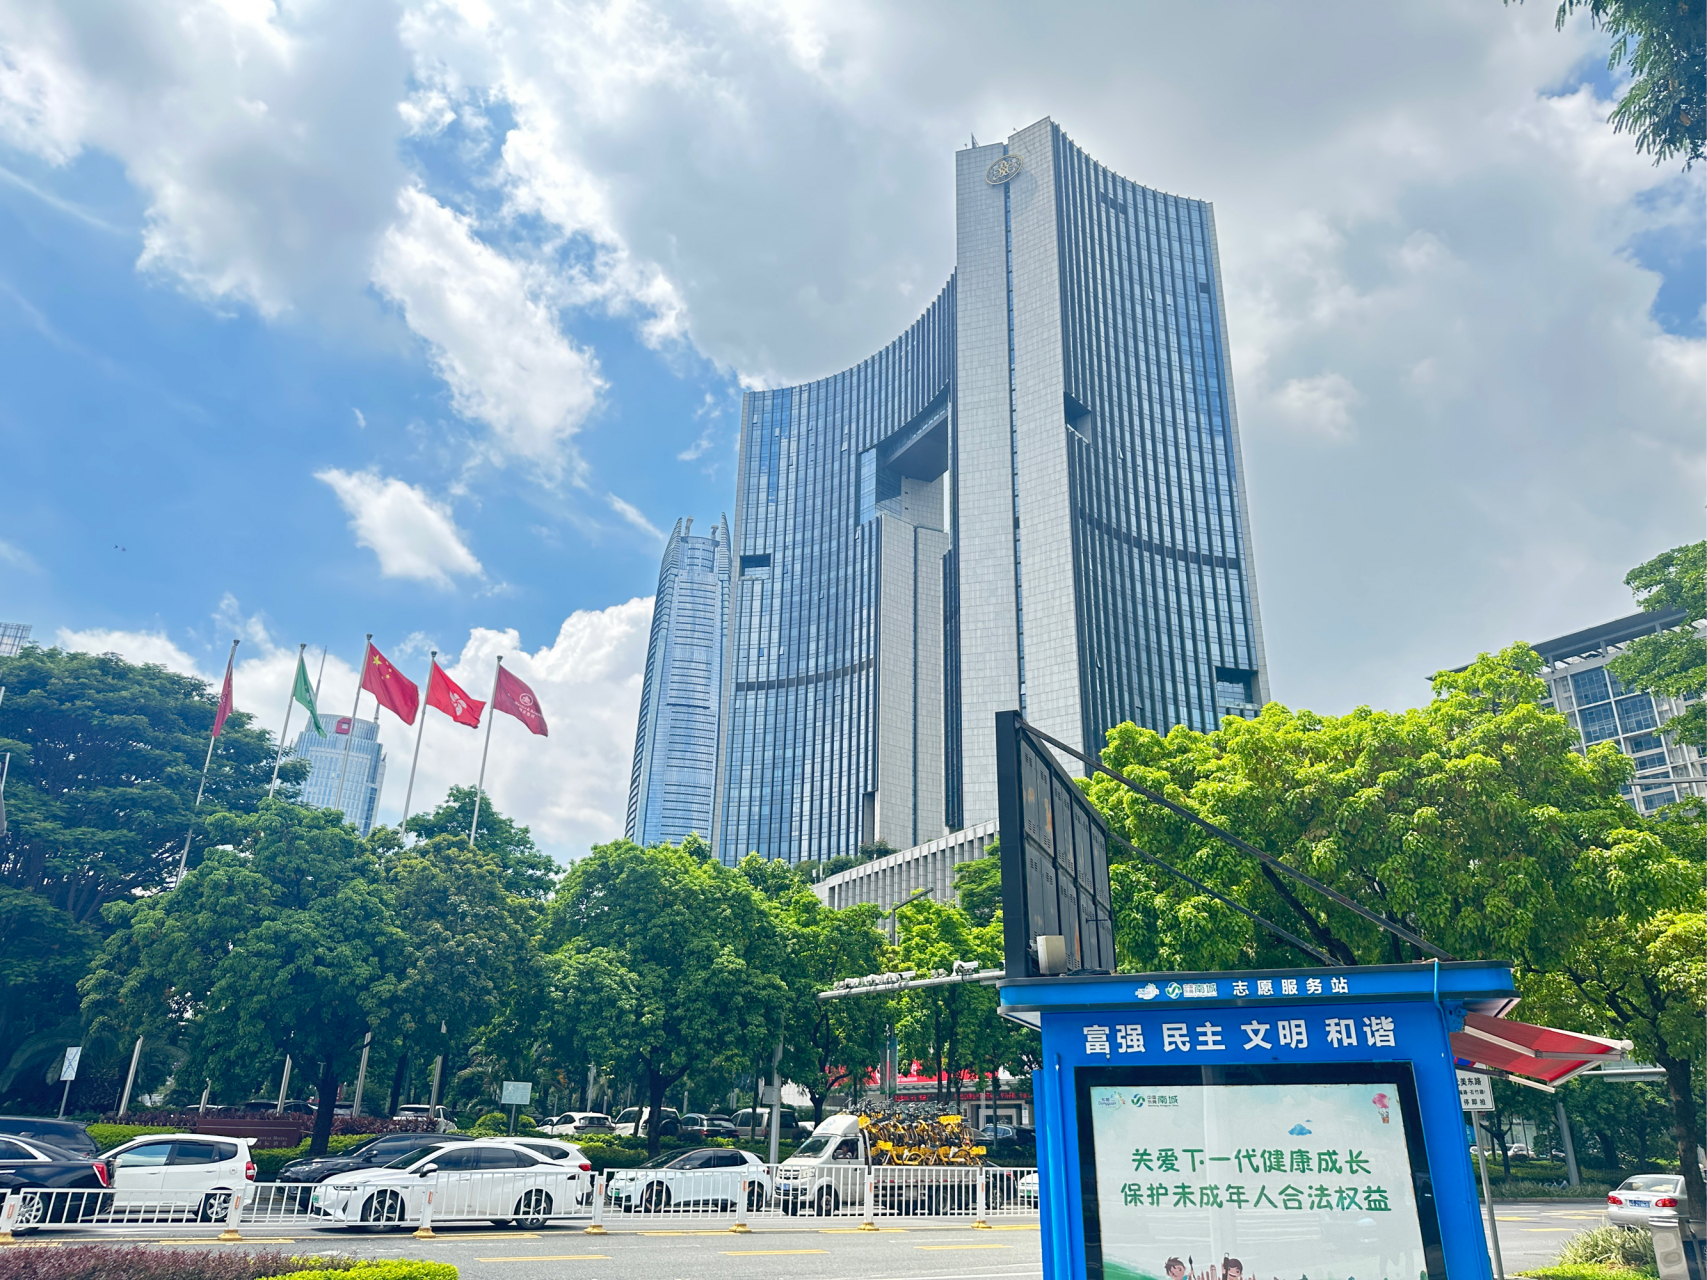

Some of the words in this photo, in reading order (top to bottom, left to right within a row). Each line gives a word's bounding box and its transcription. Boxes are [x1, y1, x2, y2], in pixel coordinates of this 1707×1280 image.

[1232, 977, 1349, 996] 志愿服务站
[1083, 1024, 1146, 1054] 富强
[1162, 1021, 1226, 1052] 民主
[1240, 1019, 1309, 1050] 文明
[1325, 1016, 1396, 1048] 和谐
[1157, 1095, 1179, 1104] 南城
[1131, 1148, 1372, 1174] 关爱下一代健康成长
[1120, 1182, 1393, 1212] 保护未成年人合法权益
